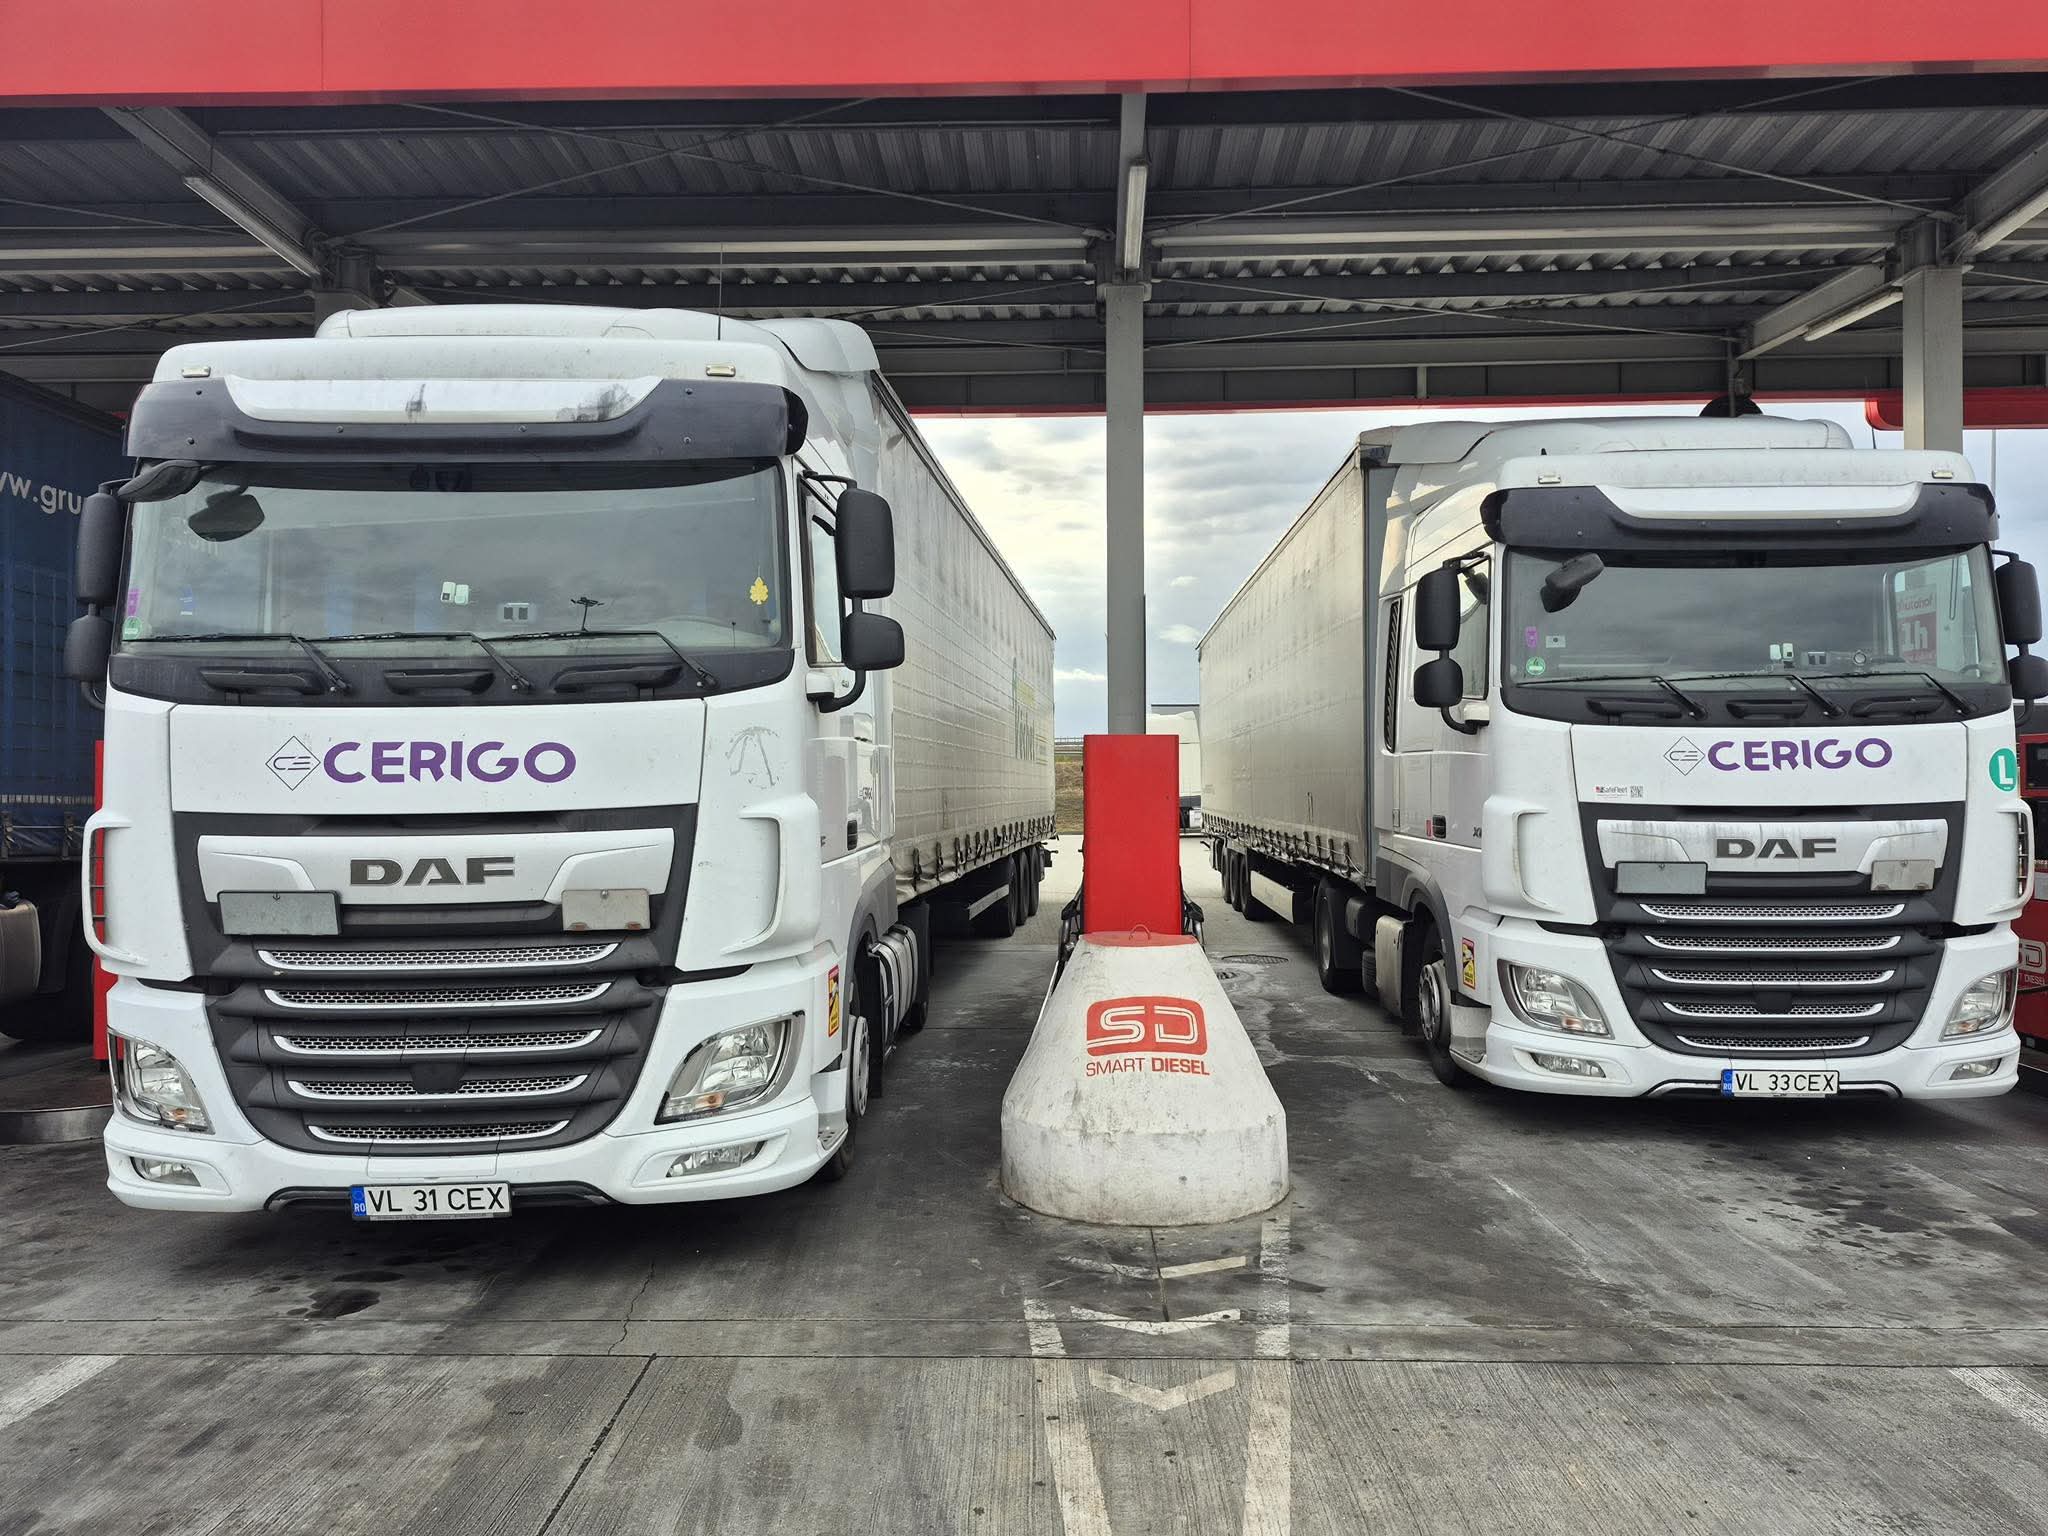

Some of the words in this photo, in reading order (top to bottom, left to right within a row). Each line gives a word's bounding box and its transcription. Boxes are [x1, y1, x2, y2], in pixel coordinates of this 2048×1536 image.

[323, 740, 577, 783] CERIGO
[1707, 737, 1893, 771] CERIGO
[1998, 755, 2014, 785] L
[1715, 838, 1837, 859] DAF
[350, 856, 516, 886] DAF
[1086, 1004, 1199, 1046] SD
[1086, 1057, 1146, 1077] SMART
[1151, 1057, 1210, 1076] DIESEL
[1735, 1073, 1759, 1091] VL
[354, 1202, 366, 1213] RO
[368, 1189, 403, 1213] VL
[413, 1188, 438, 1212] 31
[447, 1186, 505, 1211] CEX
